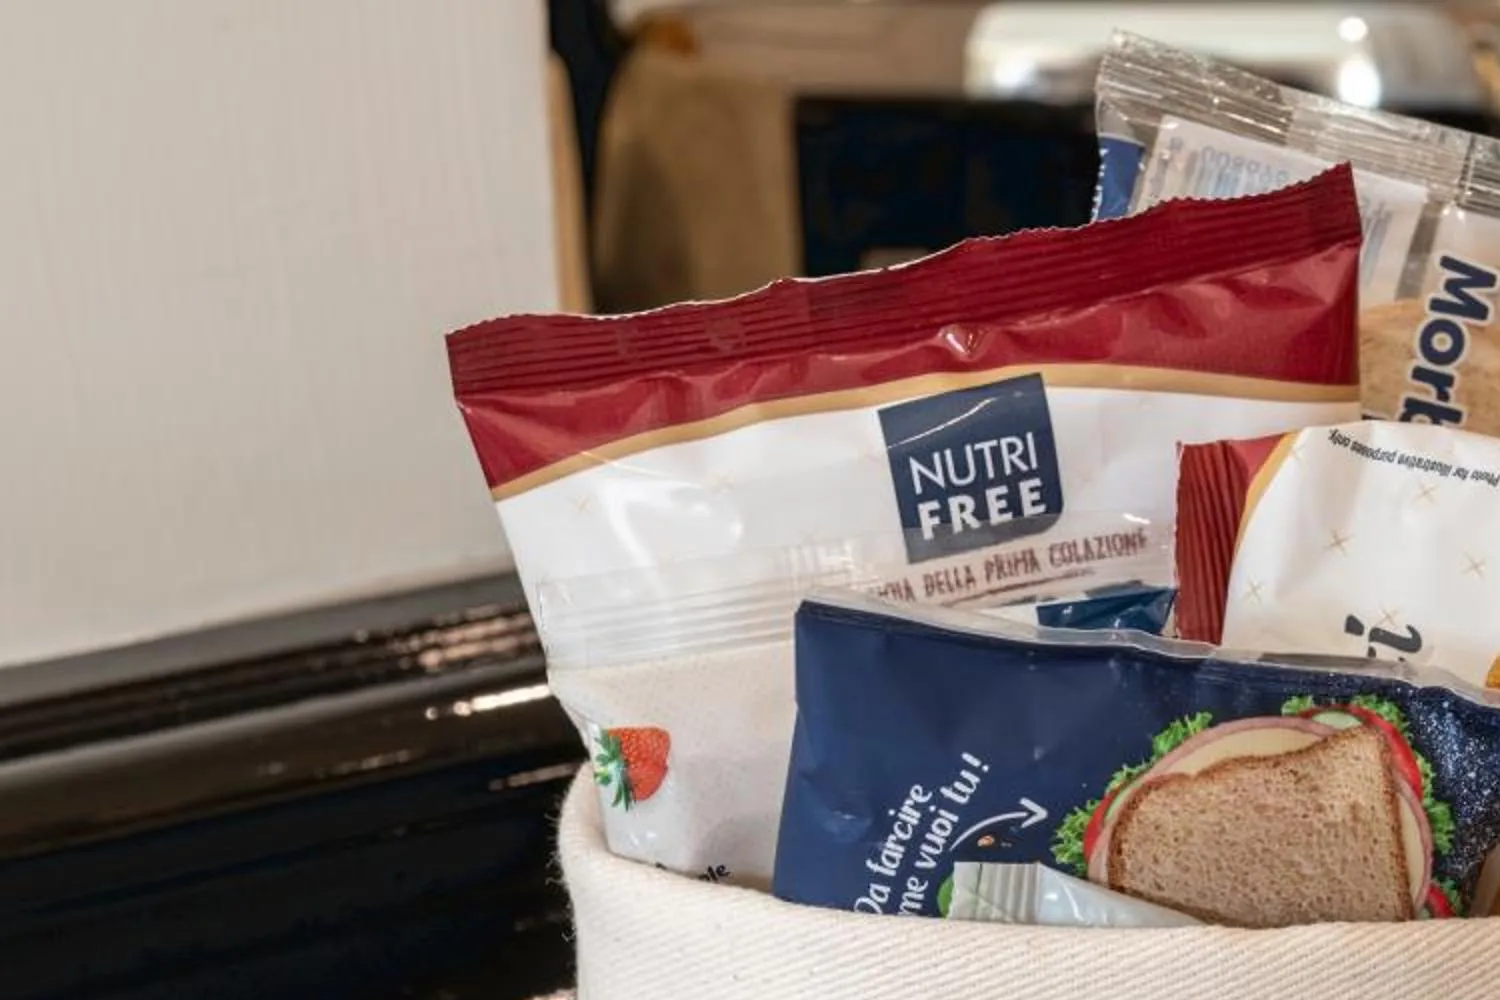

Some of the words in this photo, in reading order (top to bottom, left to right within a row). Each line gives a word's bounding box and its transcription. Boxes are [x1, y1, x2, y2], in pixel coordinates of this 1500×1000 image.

[909, 431, 1039, 495] NUTRI
[1349, 441, 1397, 464] purposes
[1452, 467, 1470, 481] for
[1470, 470, 1500, 487] Photo
[917, 477, 1047, 540] FREE
[923, 564, 978, 598] DELLA
[985, 547, 1041, 583] PRIMA
[1049, 526, 1149, 568] COLAZIONE
[865, 784, 933, 877] farcire
[914, 804, 960, 869] vuoi
